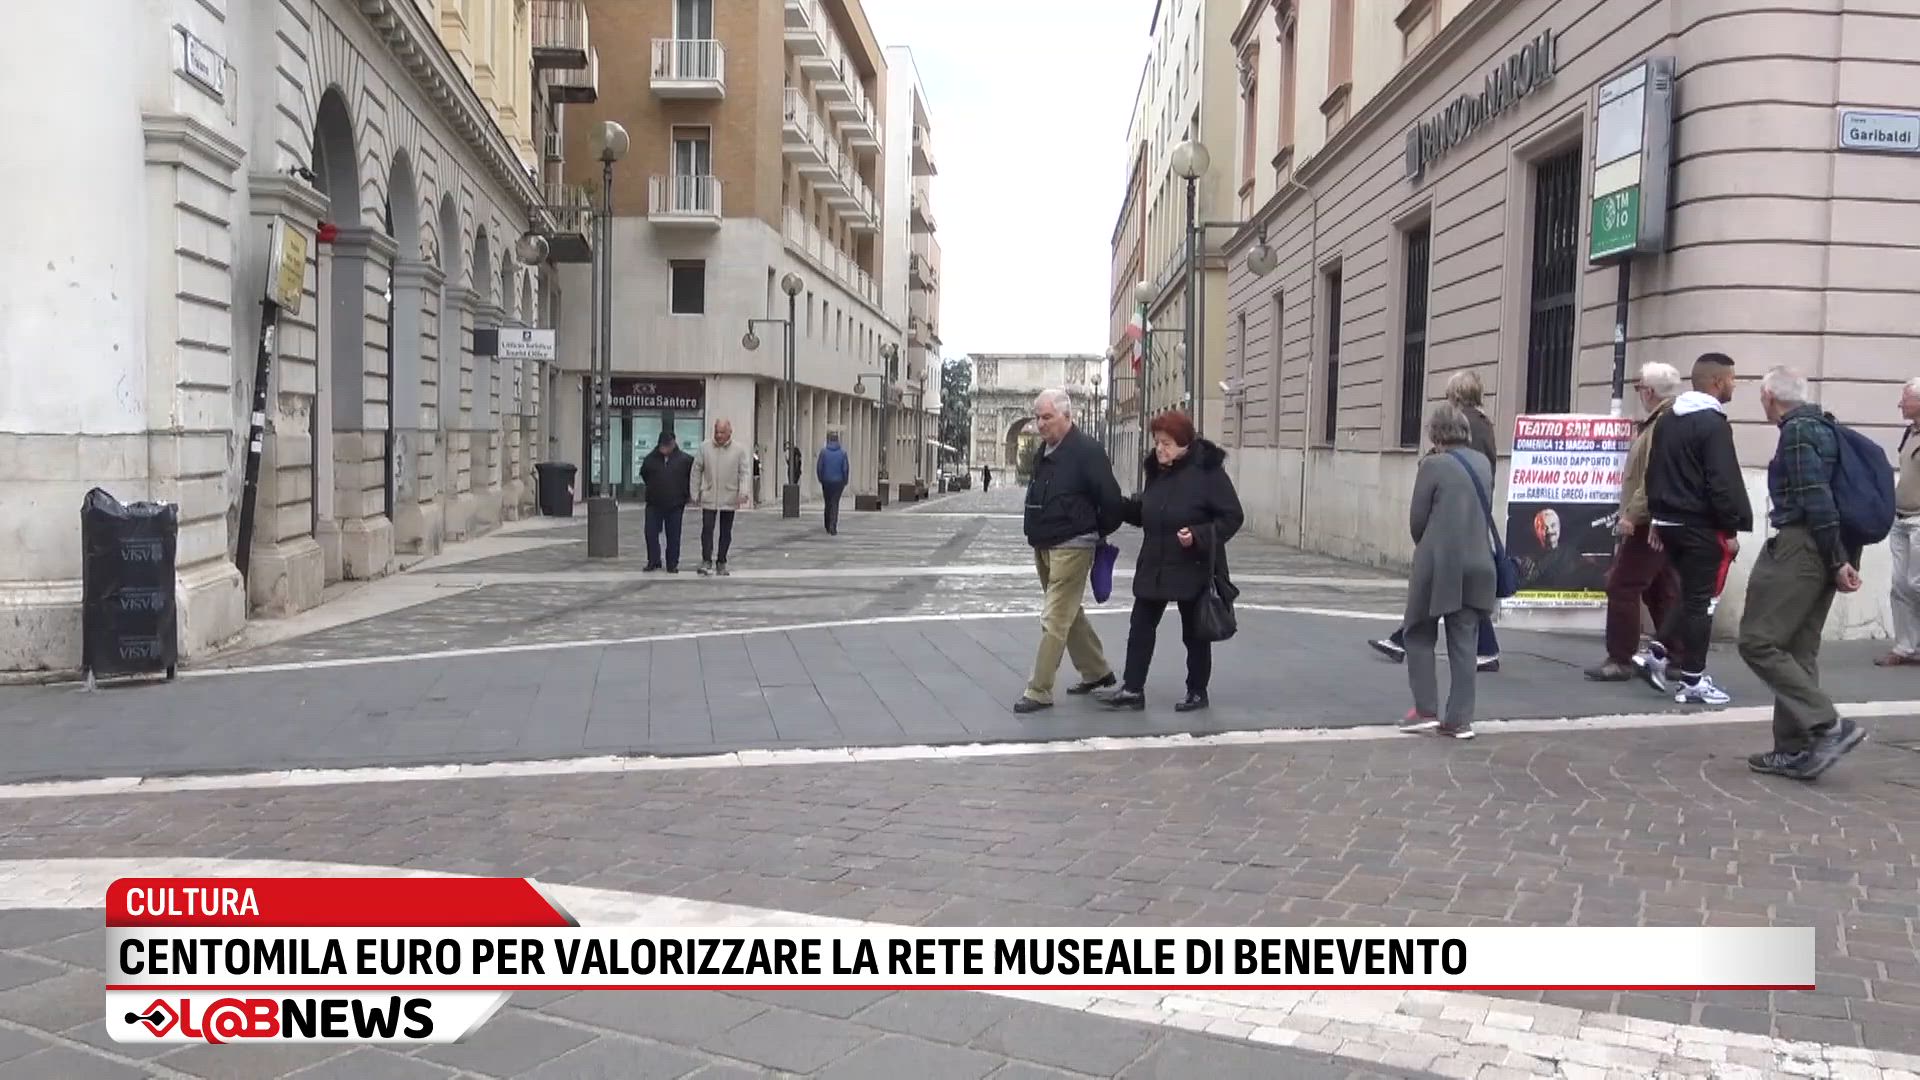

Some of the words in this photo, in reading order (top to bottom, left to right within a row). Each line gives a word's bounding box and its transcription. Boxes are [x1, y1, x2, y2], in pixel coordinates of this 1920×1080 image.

[1422, 94, 1472, 164] BANCO
[1486, 28, 1555, 118] NAPOLI
[1850, 128, 1911, 143] Garibaldi
[1518, 420, 1564, 436] TEATRO
[1565, 421, 1591, 437] SAN
[1517, 438, 1552, 450] DOMENICA
[1555, 439, 1564, 450] 12
[1565, 439, 1595, 450] MAGGIO
[1531, 455, 1568, 466] MASSIMO
[1570, 456, 1611, 466] DAPPORTO
[1512, 469, 1560, 485] ERAVAMO
[1563, 470, 1589, 485] SOLO
[1591, 470, 1604, 485] IN
[1527, 486, 1559, 500] GABRIELE
[1561, 487, 1584, 500] GRECO
